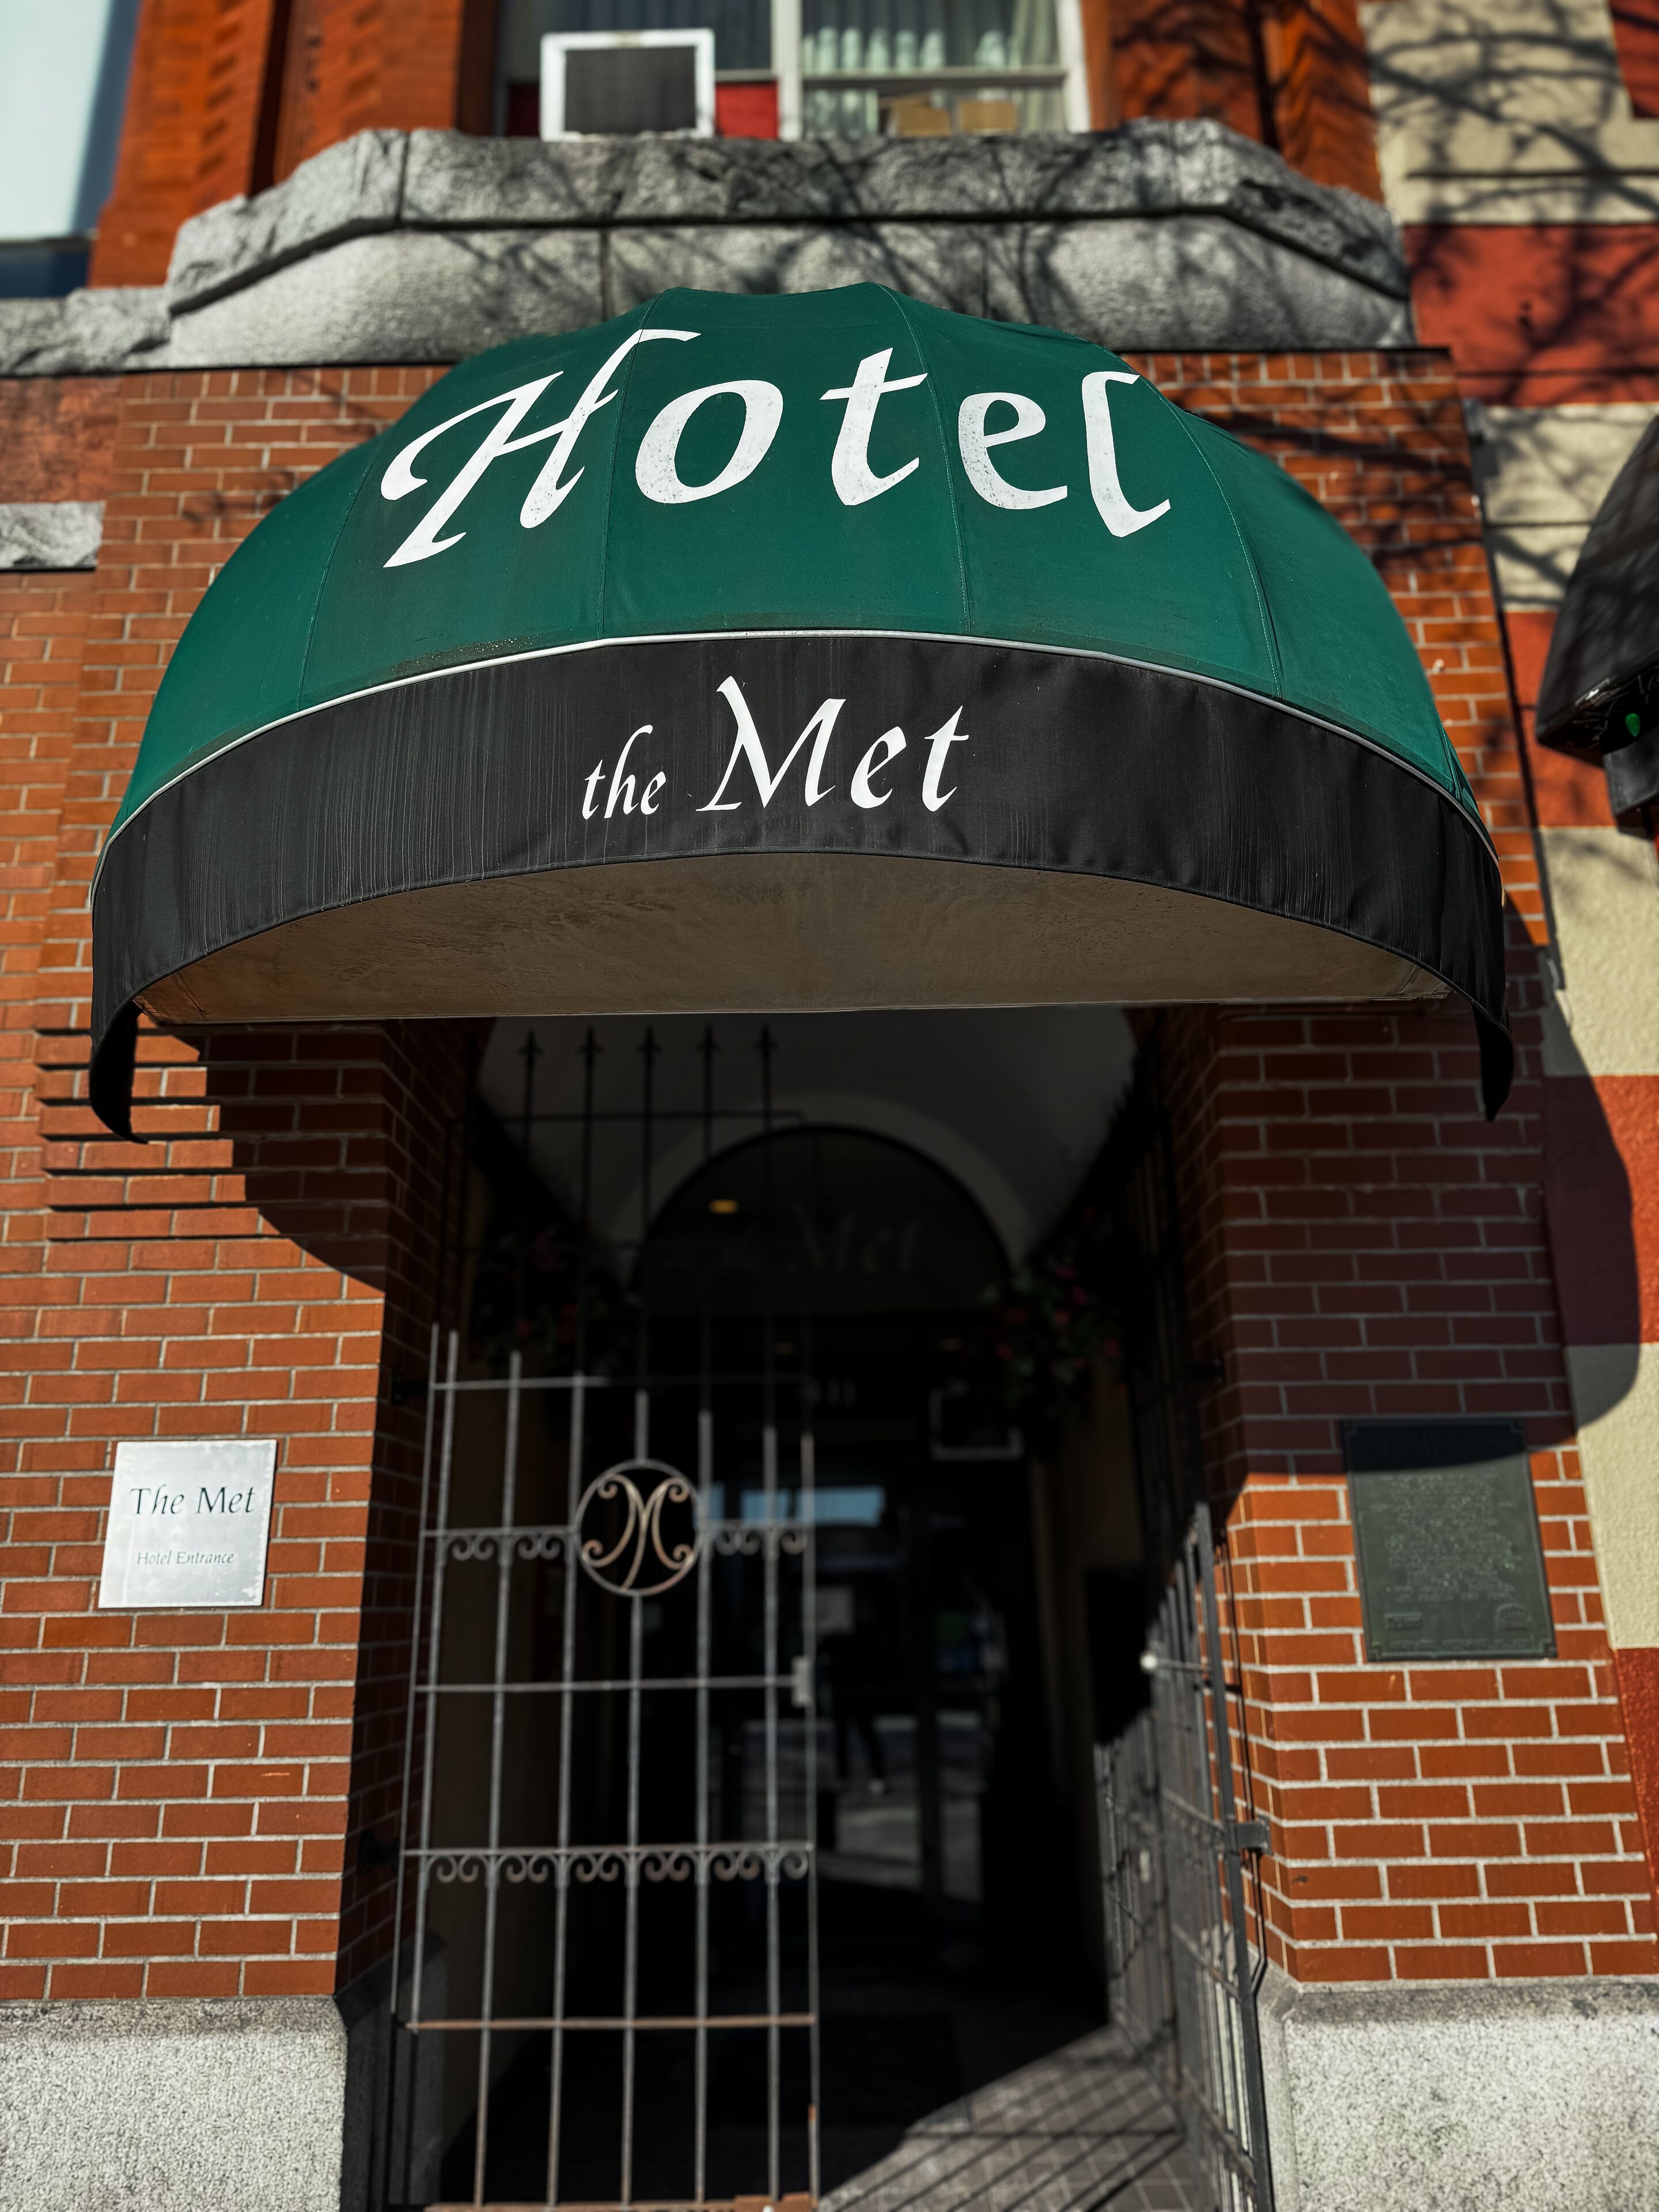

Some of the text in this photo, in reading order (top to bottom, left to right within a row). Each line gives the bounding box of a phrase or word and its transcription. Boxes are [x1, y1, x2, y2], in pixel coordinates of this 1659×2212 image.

[380, 328, 1171, 568] Hotel
[581, 675, 969, 820] the Met
[130, 1483, 256, 1514] The Met
[137, 1550, 235, 1565] Hotel Entrance
